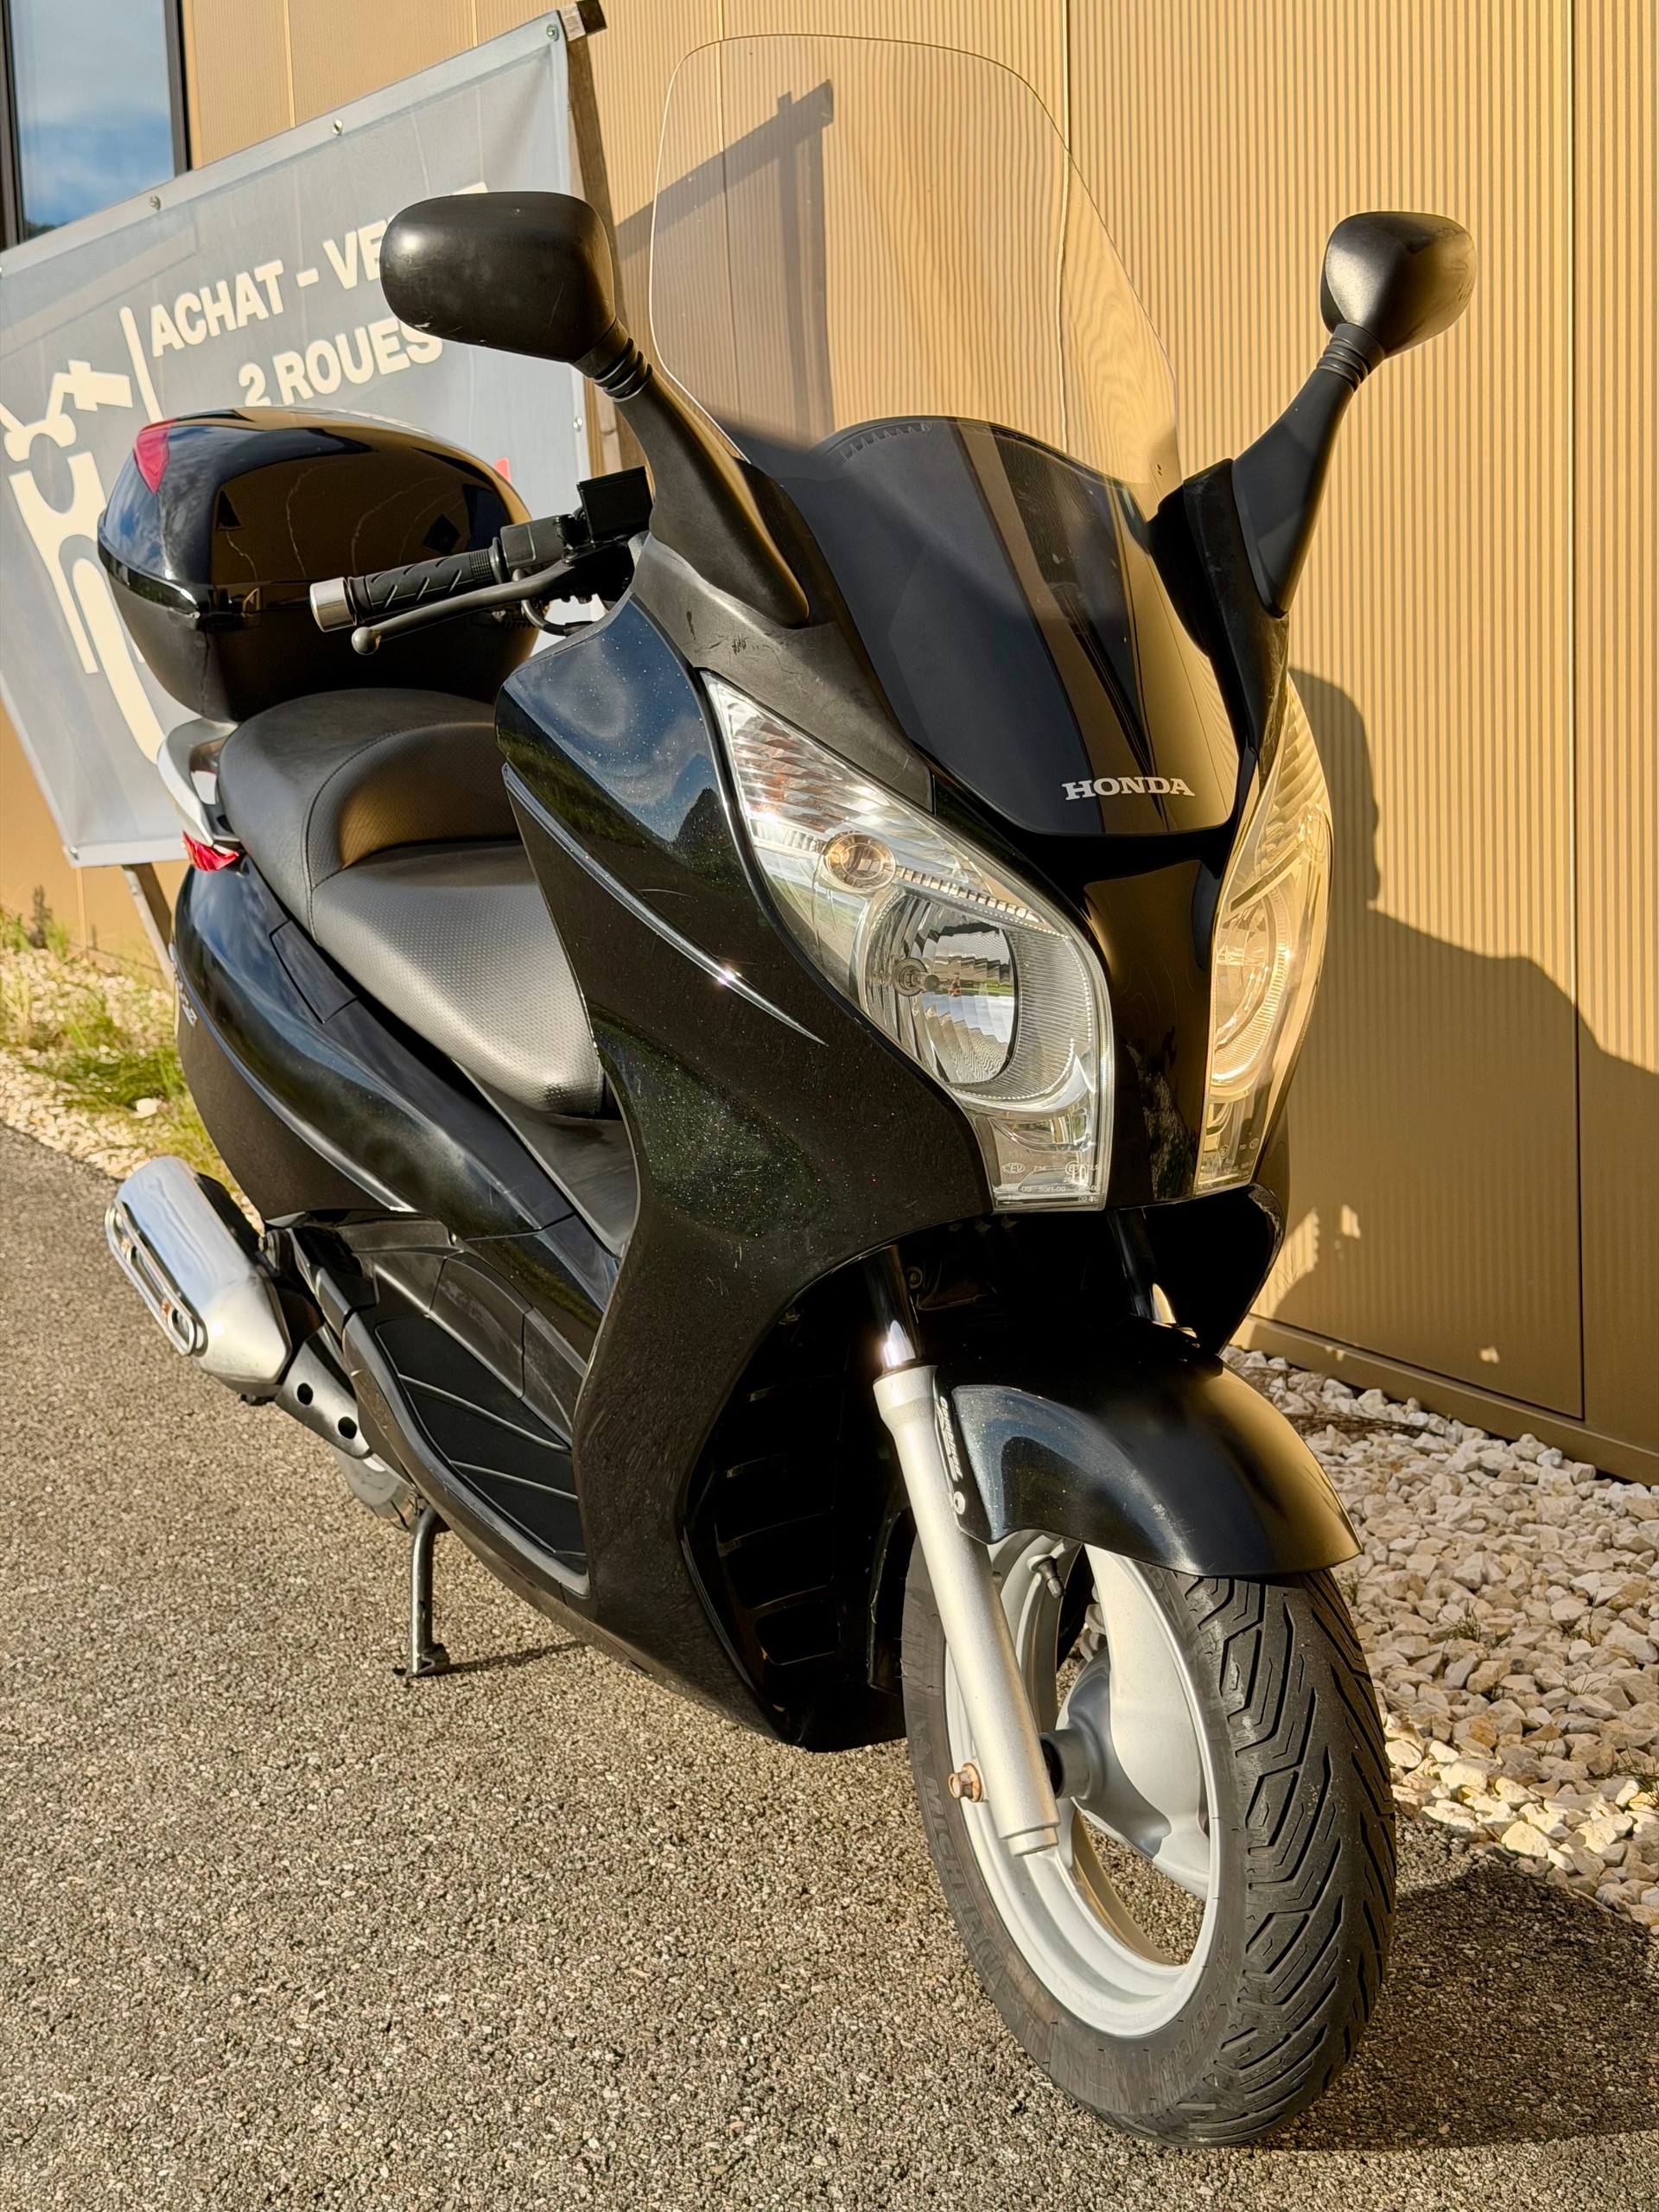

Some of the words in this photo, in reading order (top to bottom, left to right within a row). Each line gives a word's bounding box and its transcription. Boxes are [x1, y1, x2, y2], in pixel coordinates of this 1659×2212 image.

[150, 259, 284, 358] ACHAT
[238, 363, 272, 406] 2
[272, 317, 443, 406] ROUES
[1062, 777, 1196, 801] HONDA
[923, 1776, 1004, 1985] MICHELIN
